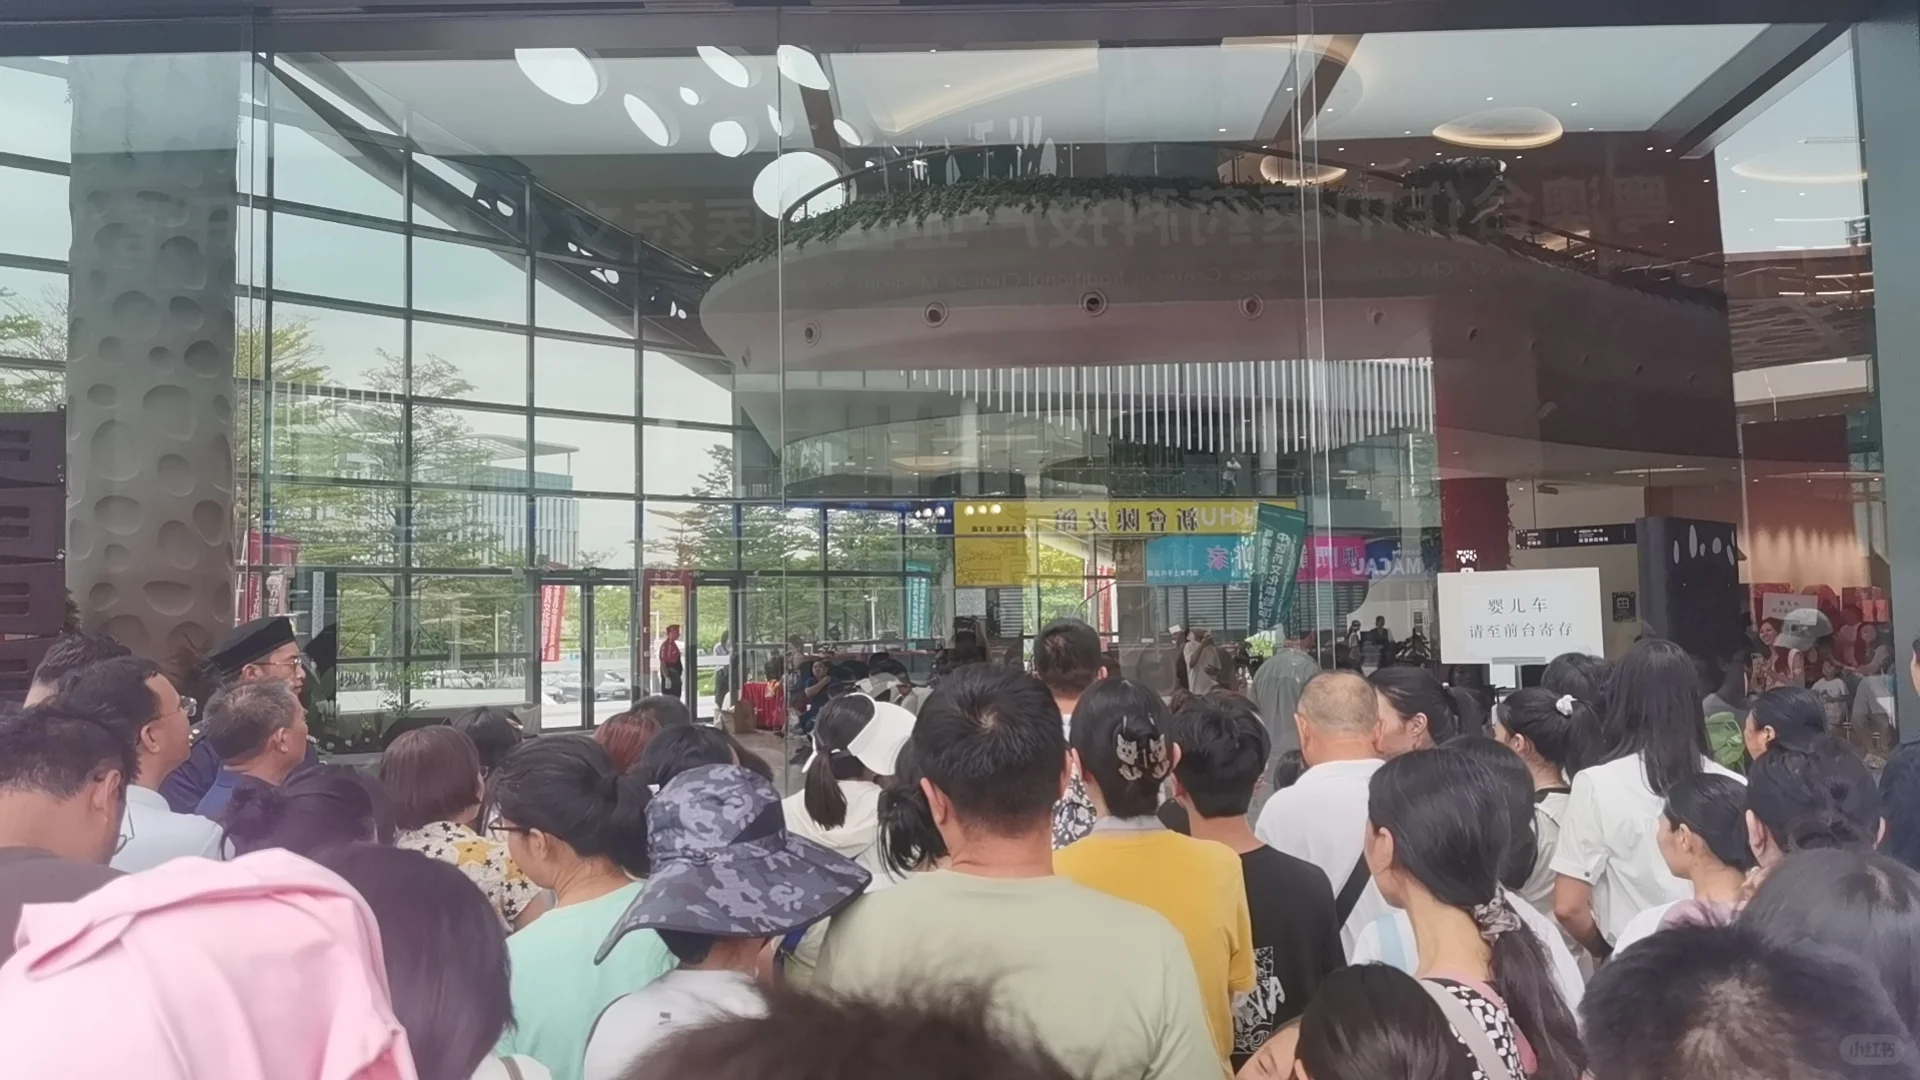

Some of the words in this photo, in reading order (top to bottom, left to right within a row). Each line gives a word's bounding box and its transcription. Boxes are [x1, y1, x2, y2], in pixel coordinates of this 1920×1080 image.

[1487, 596, 1549, 615] 婴儿车
[1468, 621, 1573, 640] 请至前台寄存
